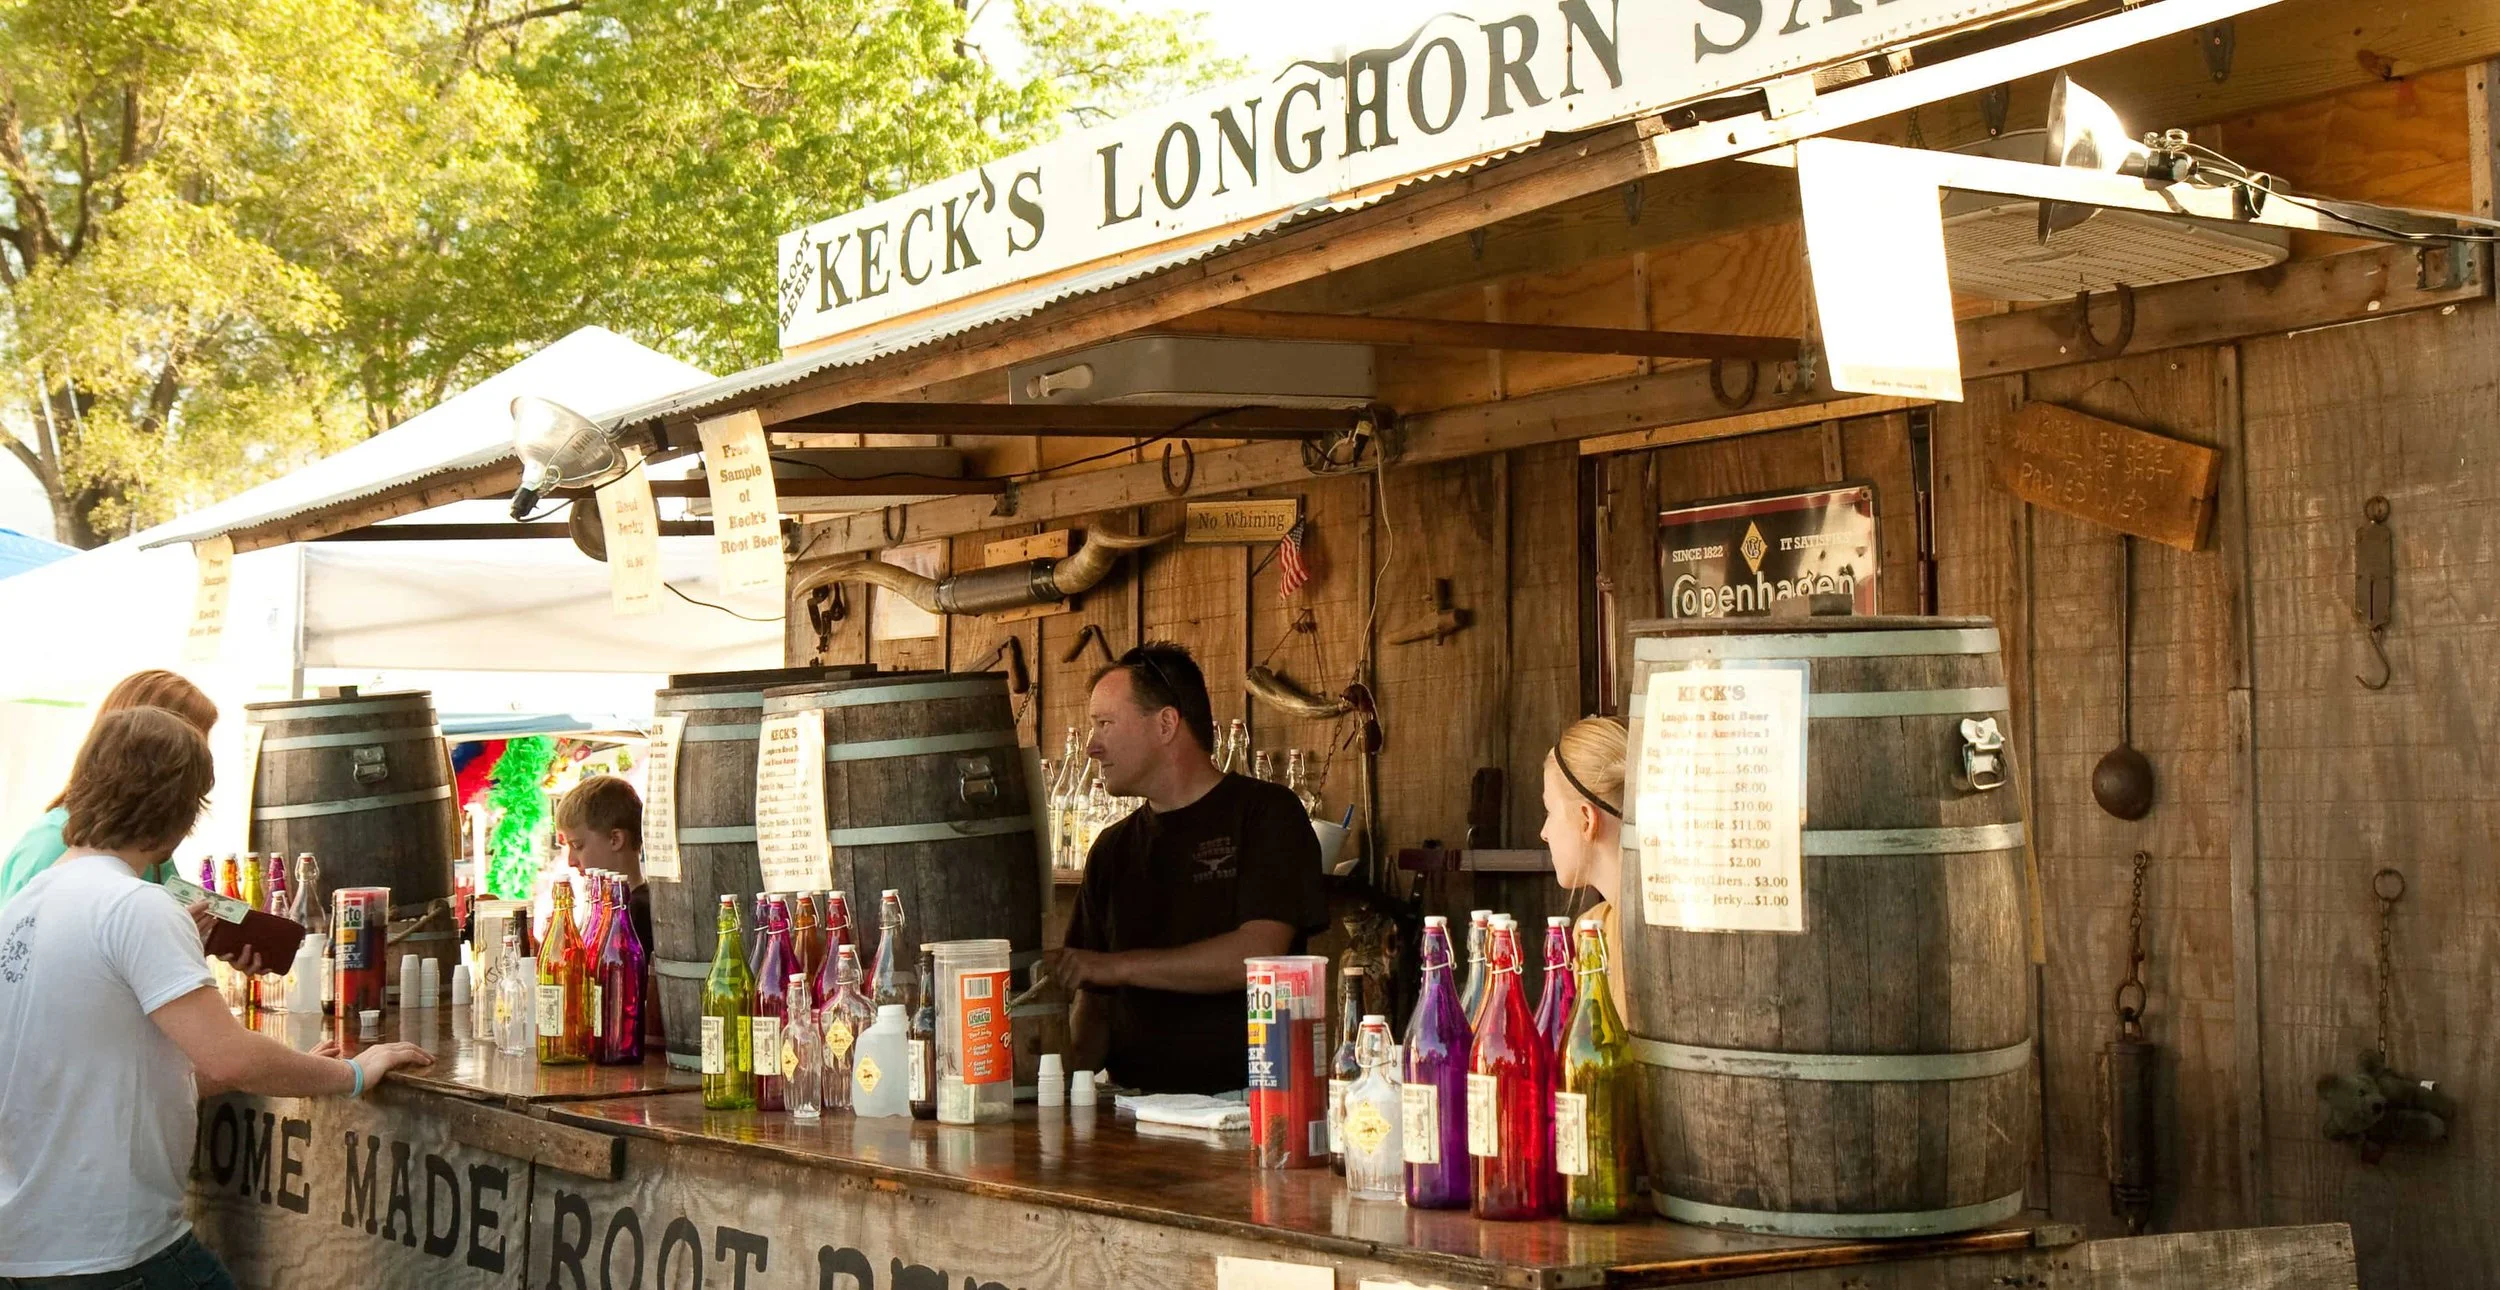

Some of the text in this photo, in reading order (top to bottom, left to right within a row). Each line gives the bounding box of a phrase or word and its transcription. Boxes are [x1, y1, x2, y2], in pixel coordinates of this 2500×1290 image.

[816, 166, 1045, 315] KECK'S
[1097, 0, 1623, 230] LONGHORN
[780, 230, 811, 300] ROOT
[780, 262, 815, 332] BEER
[720, 464, 762, 483] Sample
[739, 488, 751, 503] of
[1198, 509, 1286, 532] No Whining
[720, 533, 780, 555] Root Beer
[1672, 548, 1702, 562] SINCE
[1703, 545, 1724, 560] 1822
[1780, 537, 1793, 551] IT
[1671, 570, 1855, 620] Copenhagen
[771, 727, 798, 742] KECK'S
[1735, 764, 1768, 775] $6.00
[1734, 782, 1767, 794] $8.00
[1733, 801, 1773, 812] $10.00
[1731, 819, 1772, 831] $11.00
[1730, 838, 1770, 850] $13.00
[1728, 857, 1762, 869] $2.00
[1754, 876, 1789, 888] $3.00
[1754, 895, 1789, 907] $1.00
[193, 1101, 312, 1215] OME
[341, 1130, 509, 1275] MADE
[546, 1189, 769, 1290] ROOT
